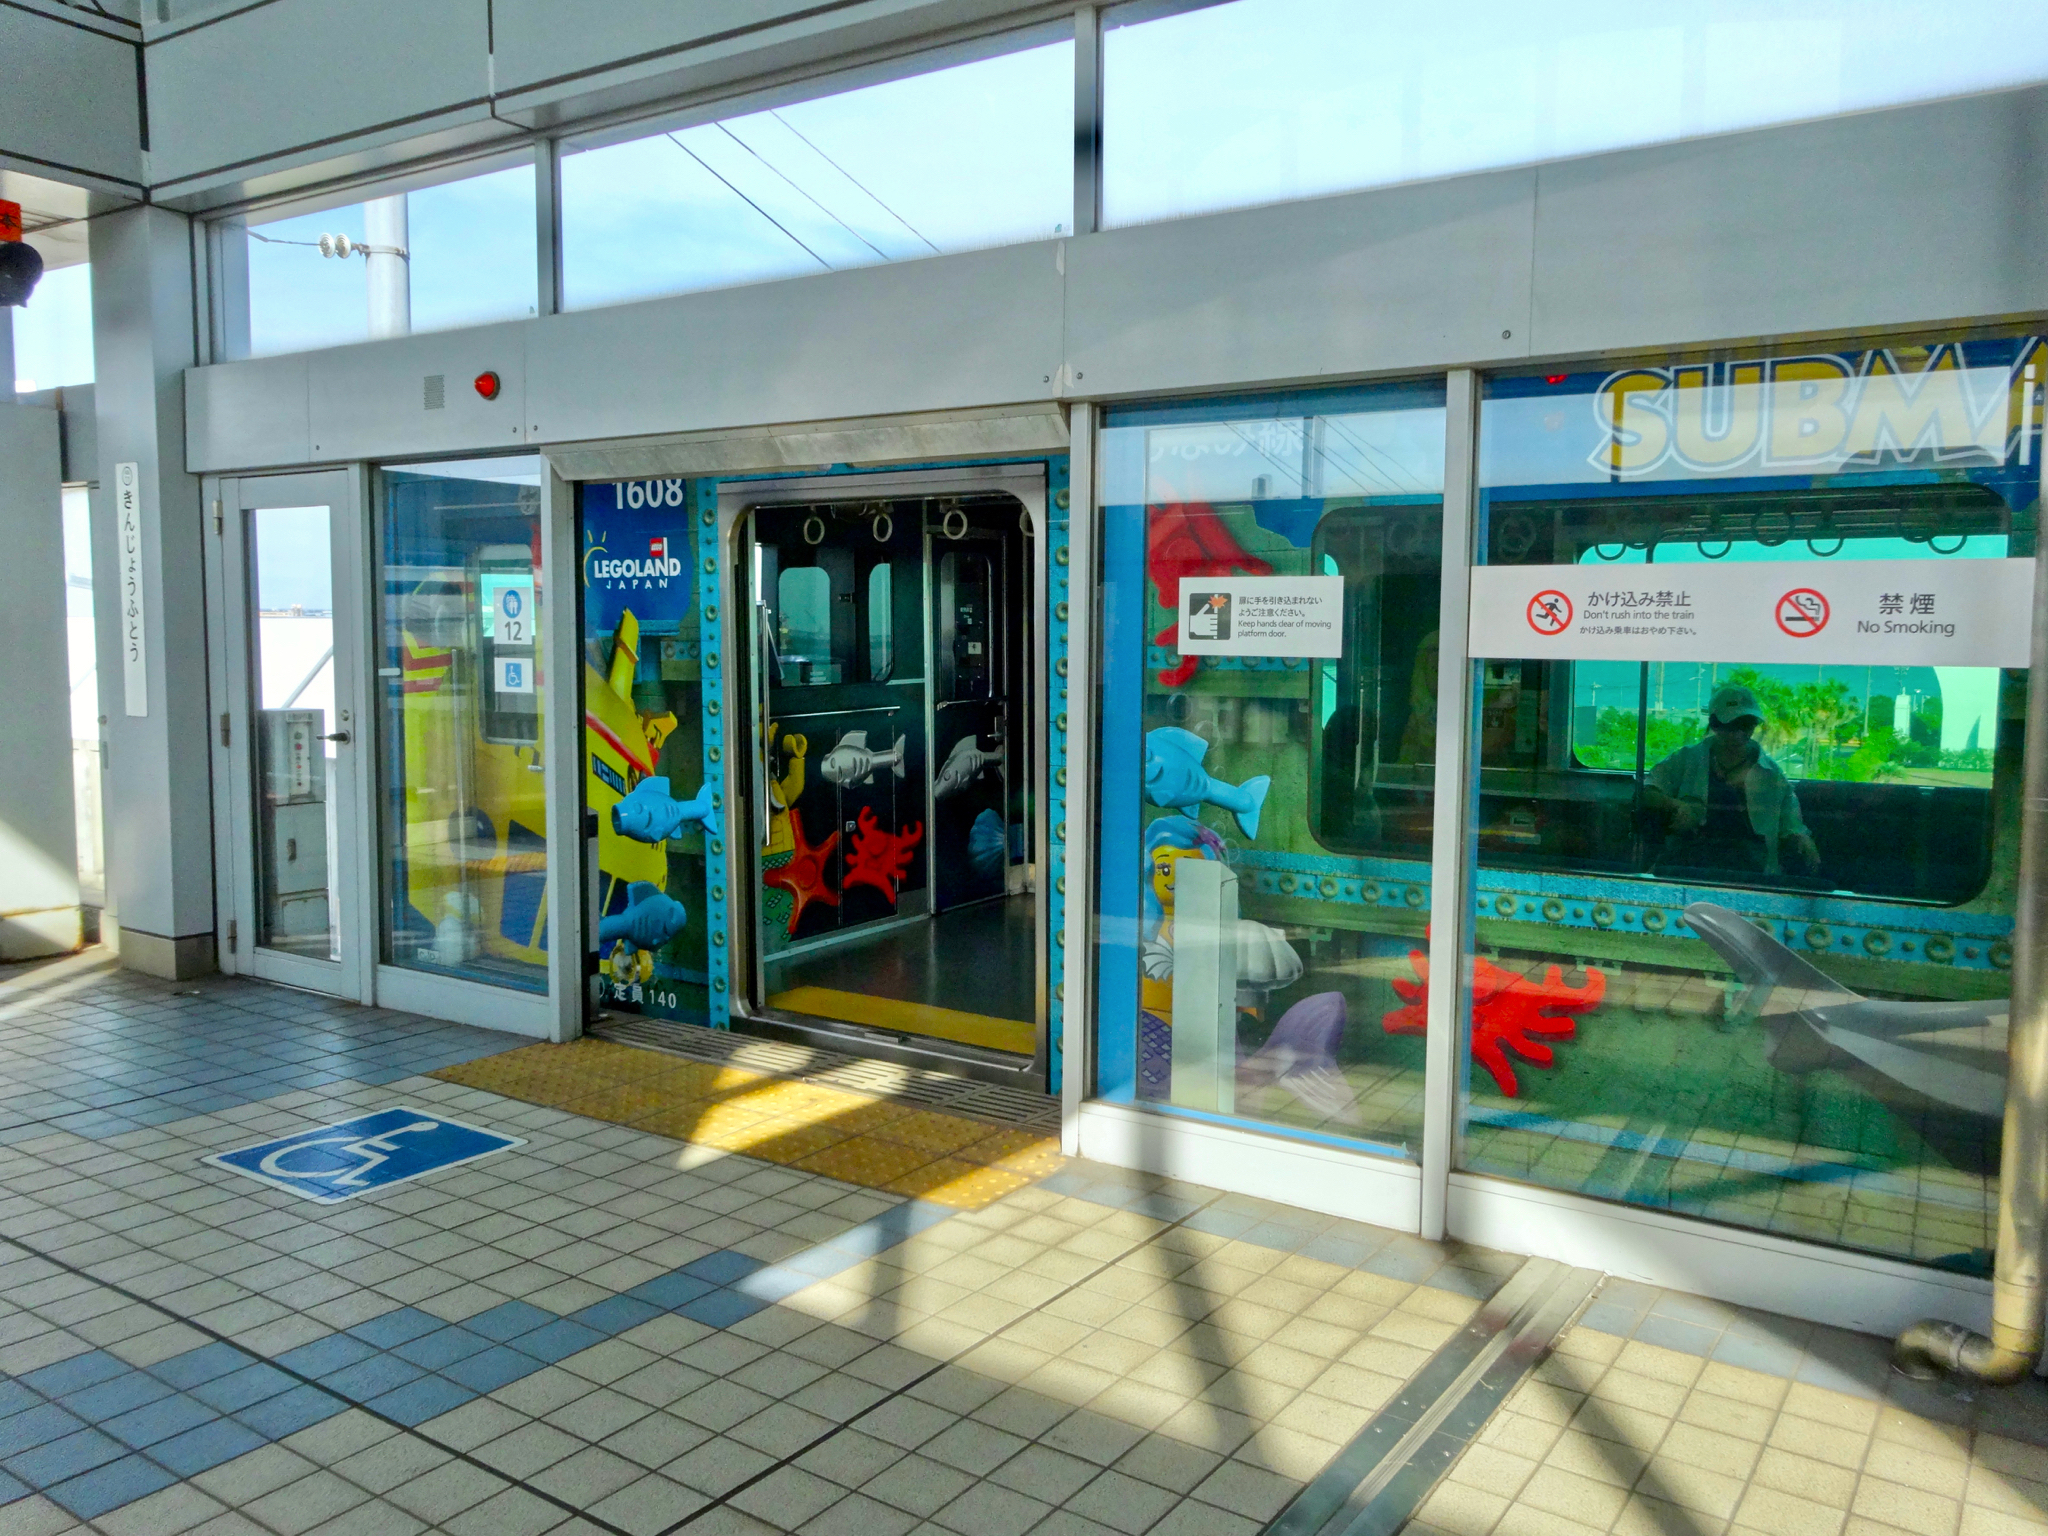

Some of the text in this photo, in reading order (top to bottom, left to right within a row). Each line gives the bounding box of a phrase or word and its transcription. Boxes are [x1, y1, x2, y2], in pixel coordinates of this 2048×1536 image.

[612, 479, 684, 510] 1608
[123, 489, 139, 662] きんじょうふとう
[594, 558, 681, 578] LEGOLAND
[606, 578, 668, 590] JAPAN
[1238, 596, 1322, 605] 扉に手を引き込まれない
[1587, 590, 1691, 607] かけ込み禁止
[1879, 592, 1936, 615] 禁煙
[1238, 608, 1305, 617] ようご注意ください。
[1583, 610, 1695, 620] Don't rush into the train
[504, 621, 522, 641] 12
[1238, 620, 1332, 629] Keep hands clear of moving
[1579, 626, 1697, 636] かけ込み乗車はおやめ下さい。
[1857, 620, 1955, 637] No Smoking
[1238, 630, 1287, 638] platform door.
[614, 982, 677, 1009] 定員 140
